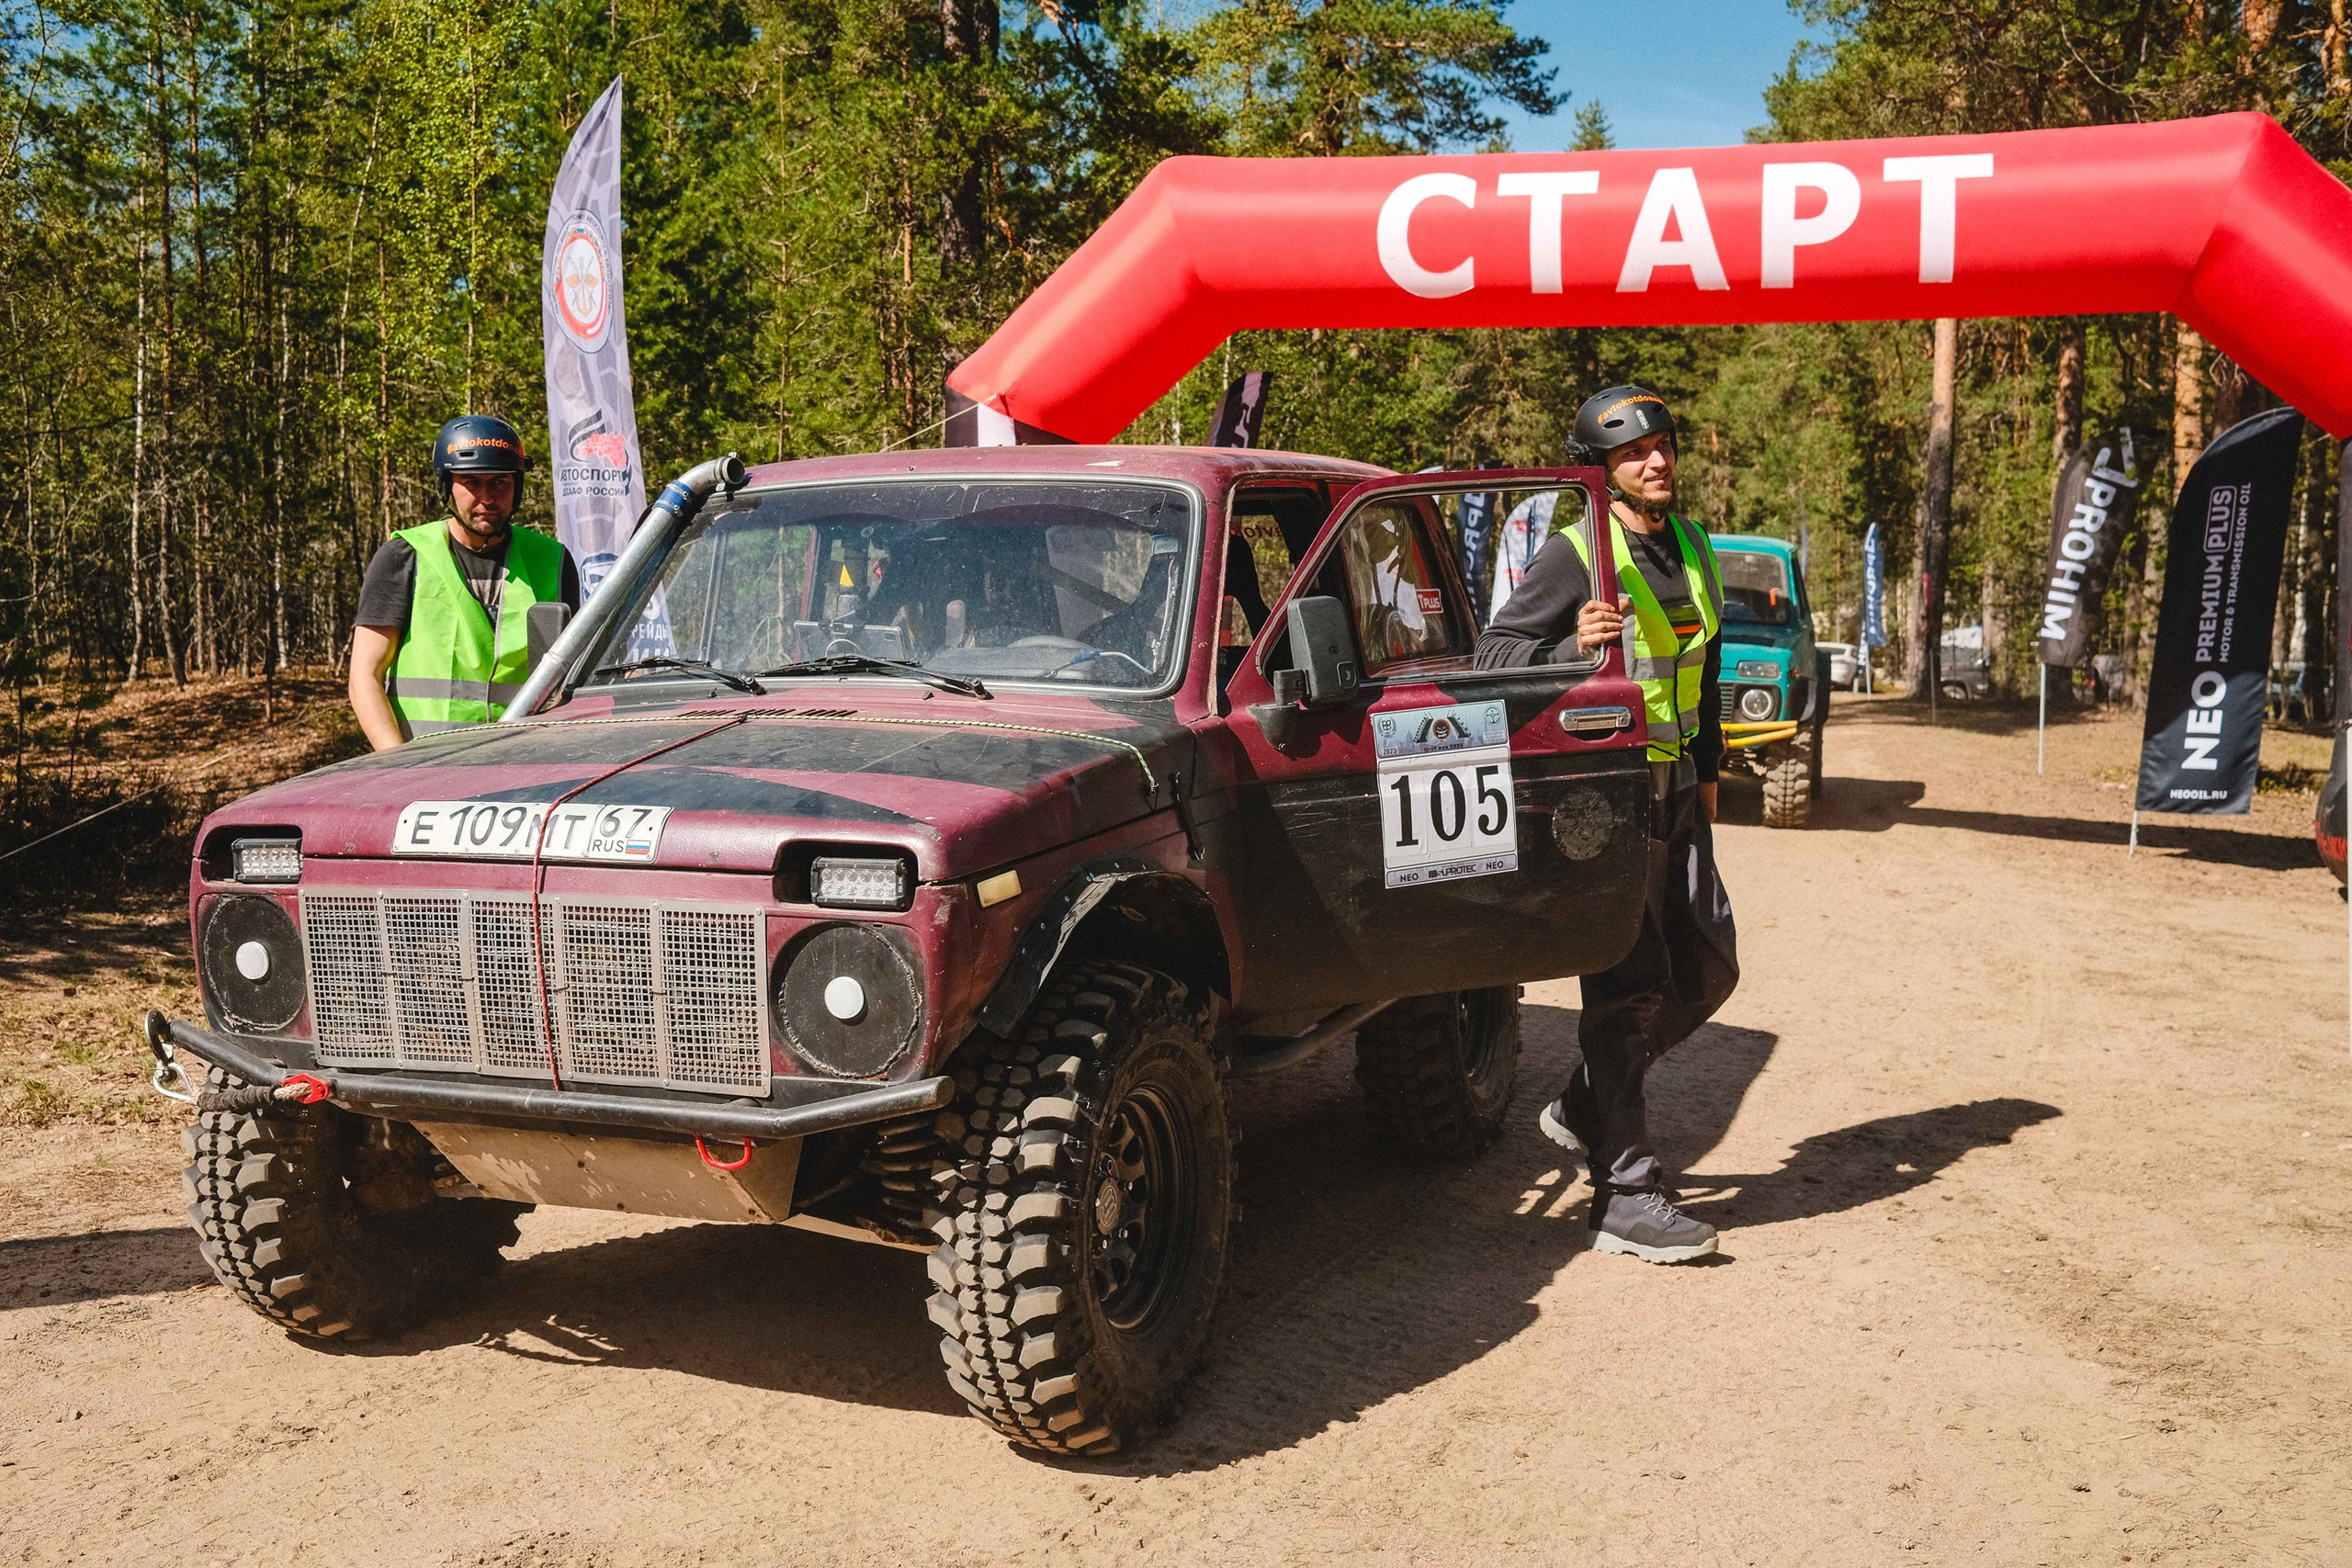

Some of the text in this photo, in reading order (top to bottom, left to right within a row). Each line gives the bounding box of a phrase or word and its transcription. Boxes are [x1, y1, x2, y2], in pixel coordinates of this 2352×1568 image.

[1376, 152, 1995, 299] СТАРТ
[2195, 490, 2233, 662] PREMIUM PLUS
[2219, 482, 2251, 662] MOTOR & TRANSMISSION OIL
[2181, 671, 2227, 771] NEO
[1383, 747, 1397, 755] 2023
[599, 807, 653, 839] 67
[1390, 765, 1509, 848] 105
[2169, 789, 2228, 800] NEOOIL.RU
[591, 839, 625, 853] RUS
[1400, 873, 1419, 883] NEO
[1486, 861, 1504, 871] NEO
